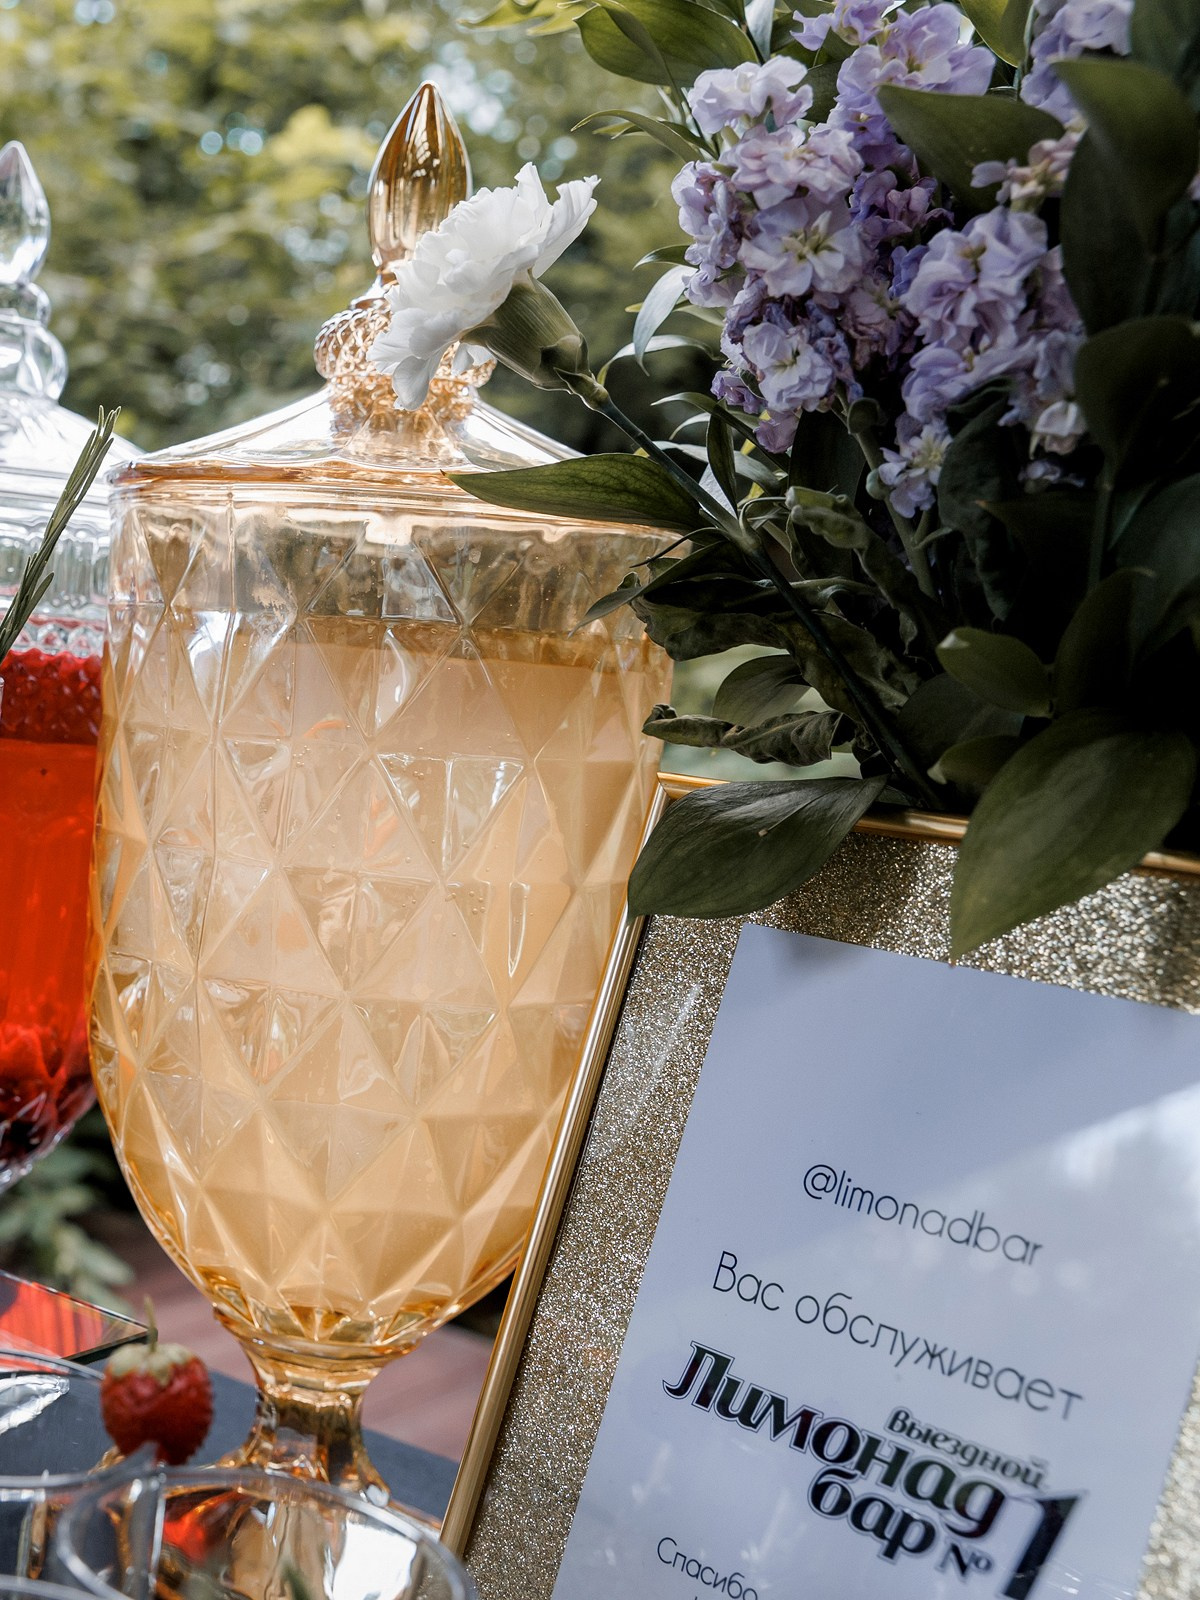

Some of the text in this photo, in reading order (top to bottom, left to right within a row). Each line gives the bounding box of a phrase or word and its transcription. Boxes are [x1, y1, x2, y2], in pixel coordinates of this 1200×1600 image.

[803, 1164, 1043, 1266] @limonadbar
[712, 1250, 1084, 1421] Вас обслуживает
[663, 1341, 1006, 1539] Лимонад
[808, 1466, 937, 1563] бар
[657, 1537, 758, 1600] Спасибо
